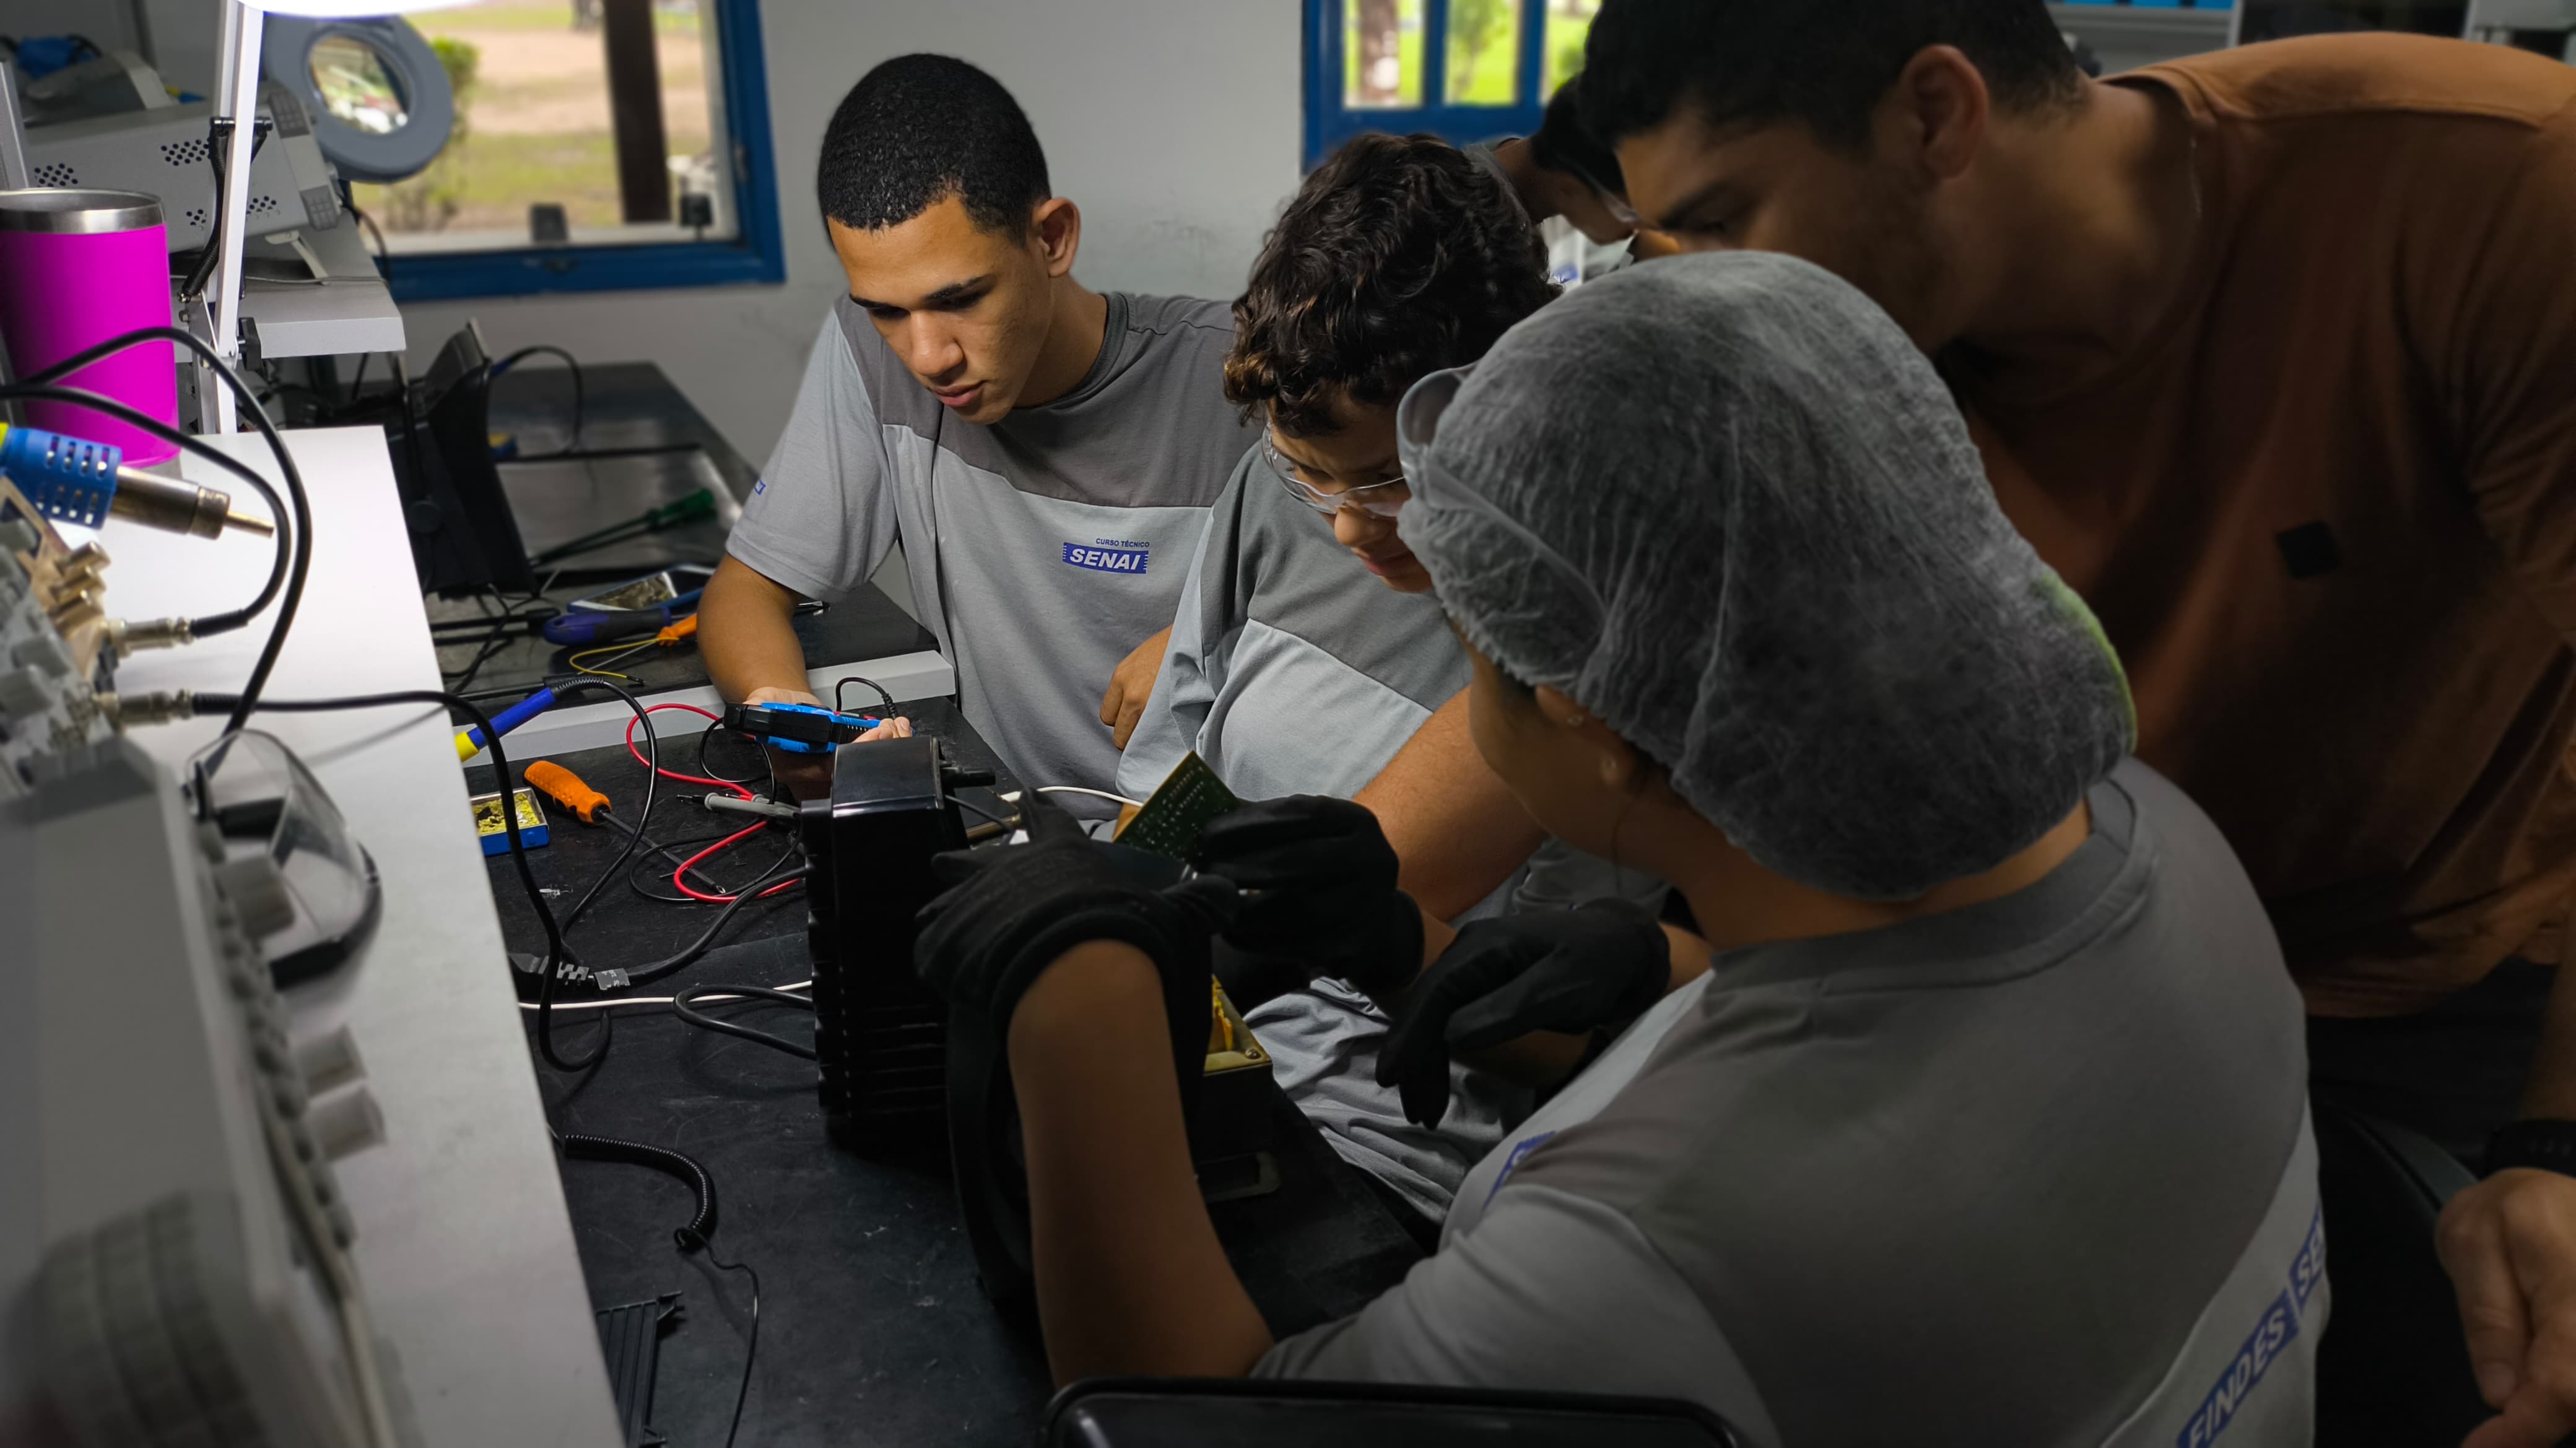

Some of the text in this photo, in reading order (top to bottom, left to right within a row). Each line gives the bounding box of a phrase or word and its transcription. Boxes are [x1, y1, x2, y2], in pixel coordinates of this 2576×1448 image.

[1096, 538, 1150, 548] CURSO TÉCNICO
[1069, 548, 1141, 570] SENAI
[2189, 1306, 2286, 1448] FINDES
